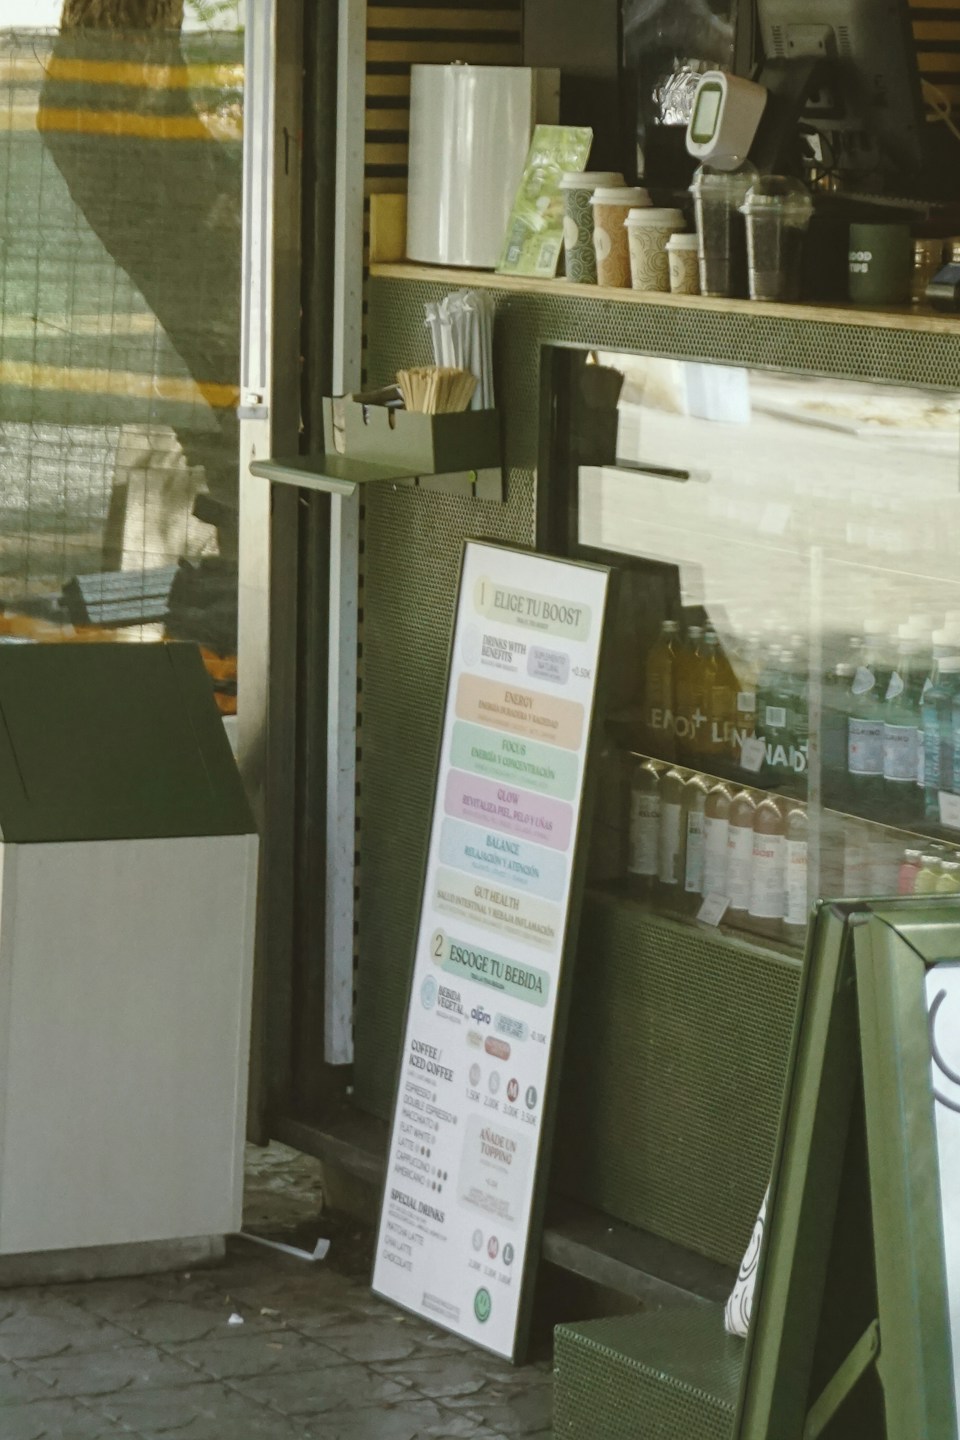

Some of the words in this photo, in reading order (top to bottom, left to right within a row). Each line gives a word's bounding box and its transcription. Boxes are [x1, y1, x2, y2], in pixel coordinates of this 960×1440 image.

[494, 590, 525, 614] ELIGE
[526, 597, 541, 617] TU
[542, 601, 582, 627] BOOST
[481, 645, 513, 663] BENEFITS
[483, 634, 508, 651] DRINKS
[508, 640, 527, 655] WITH
[504, 690, 535, 709] ENERGY
[502, 739, 527, 757] FOCUS
[462, 794, 497, 814] REVITALIZA
[497, 788, 520, 805] GLOW
[486, 834, 520, 856] BALANCE
[474, 884, 490, 901] GUT
[490, 890, 520, 911] HEALTH
[434, 934, 444, 958] 2
[449, 944, 489, 973] ESCOGE
[490, 958, 504, 979] TU
[505, 965, 544, 994] BEBIDA
[437, 996, 464, 1016] VEGETAL
[470, 1007, 492, 1026] alpro
[411, 1038, 438, 1061] COFFEE
[409, 1053, 427, 1070] ICED
[426, 1060, 455, 1082] COFFEE
[480, 1127, 505, 1149] AÑADE
[505, 1138, 517, 1153] UN
[480, 1141, 512, 1166] TOPPING
[390, 1187, 418, 1211] SPECIAL
[417, 1200, 446, 1224] DRINKS
